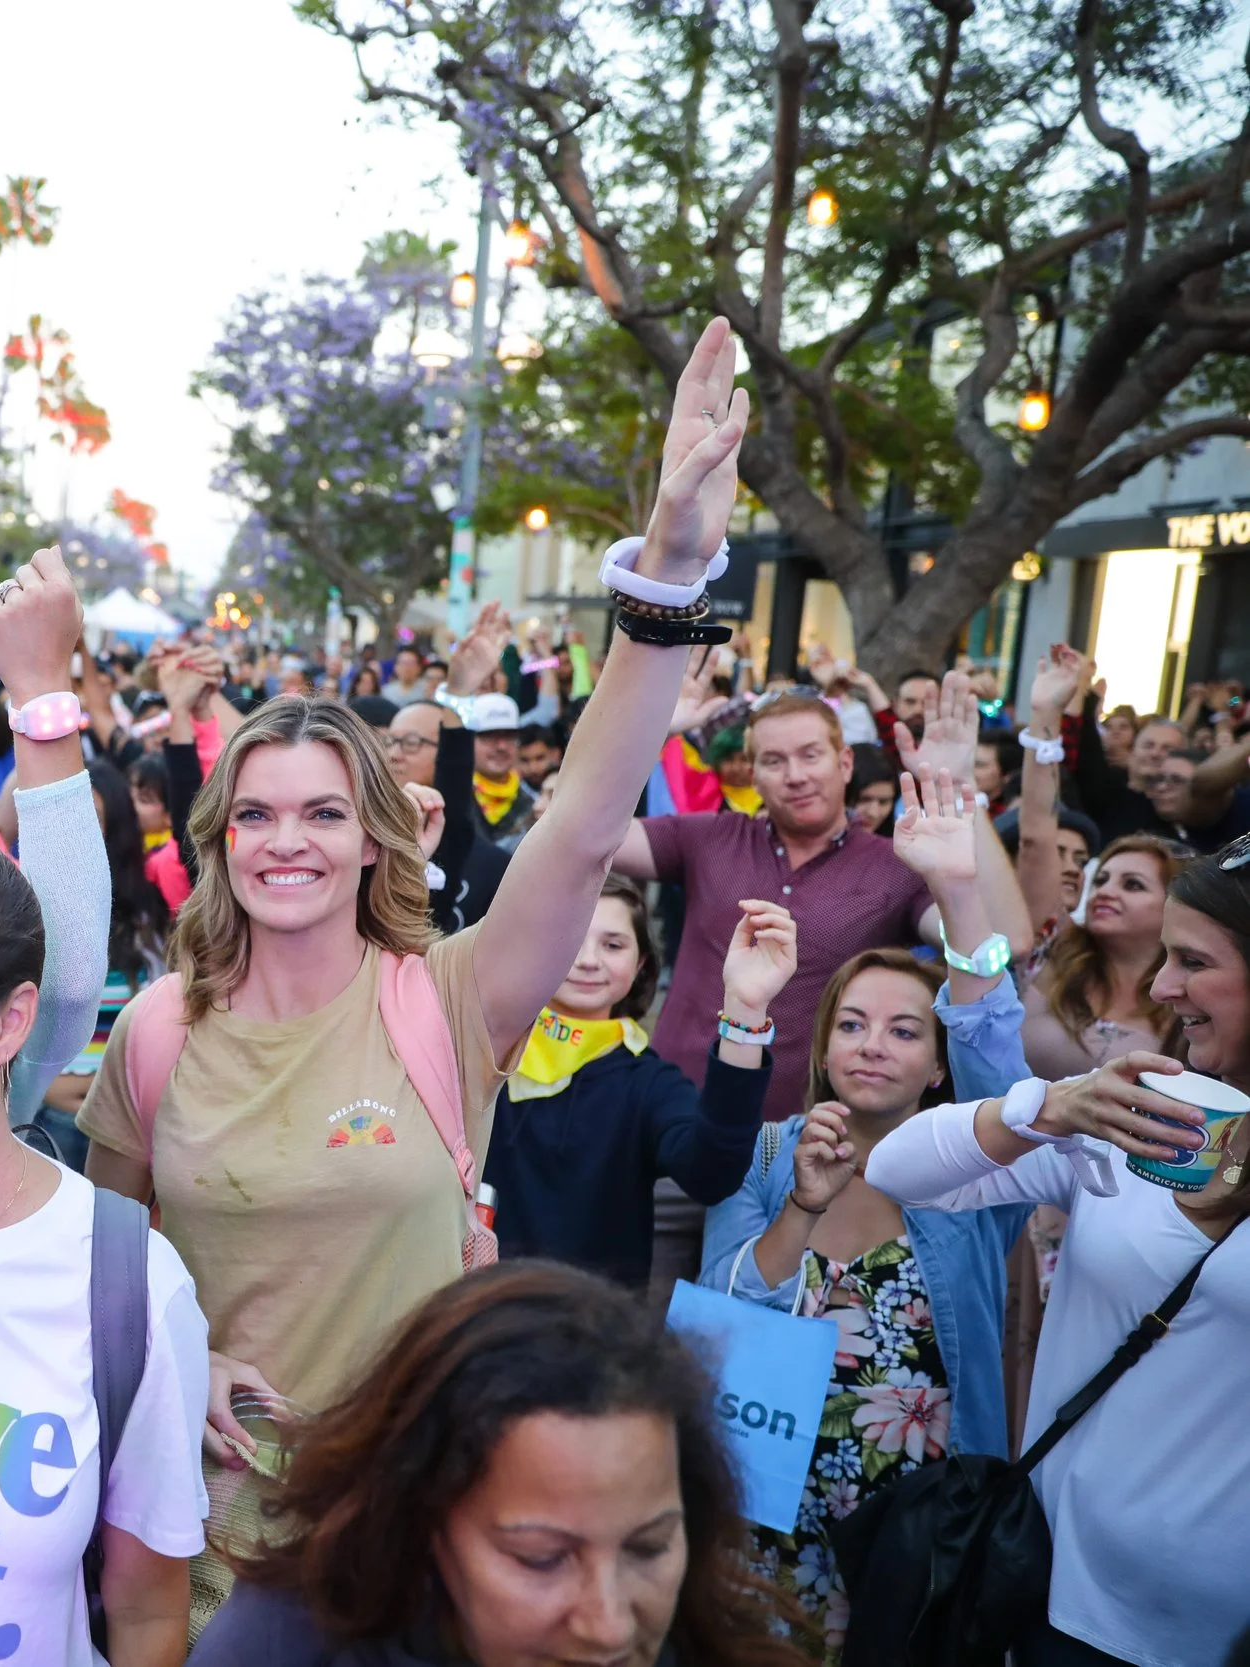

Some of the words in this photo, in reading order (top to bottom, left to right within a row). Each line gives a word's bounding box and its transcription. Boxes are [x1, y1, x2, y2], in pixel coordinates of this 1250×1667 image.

[1167, 513, 1215, 547] THE
[1136, 1168, 1185, 1189] AMERICAN
[717, 1392, 797, 1441] son
